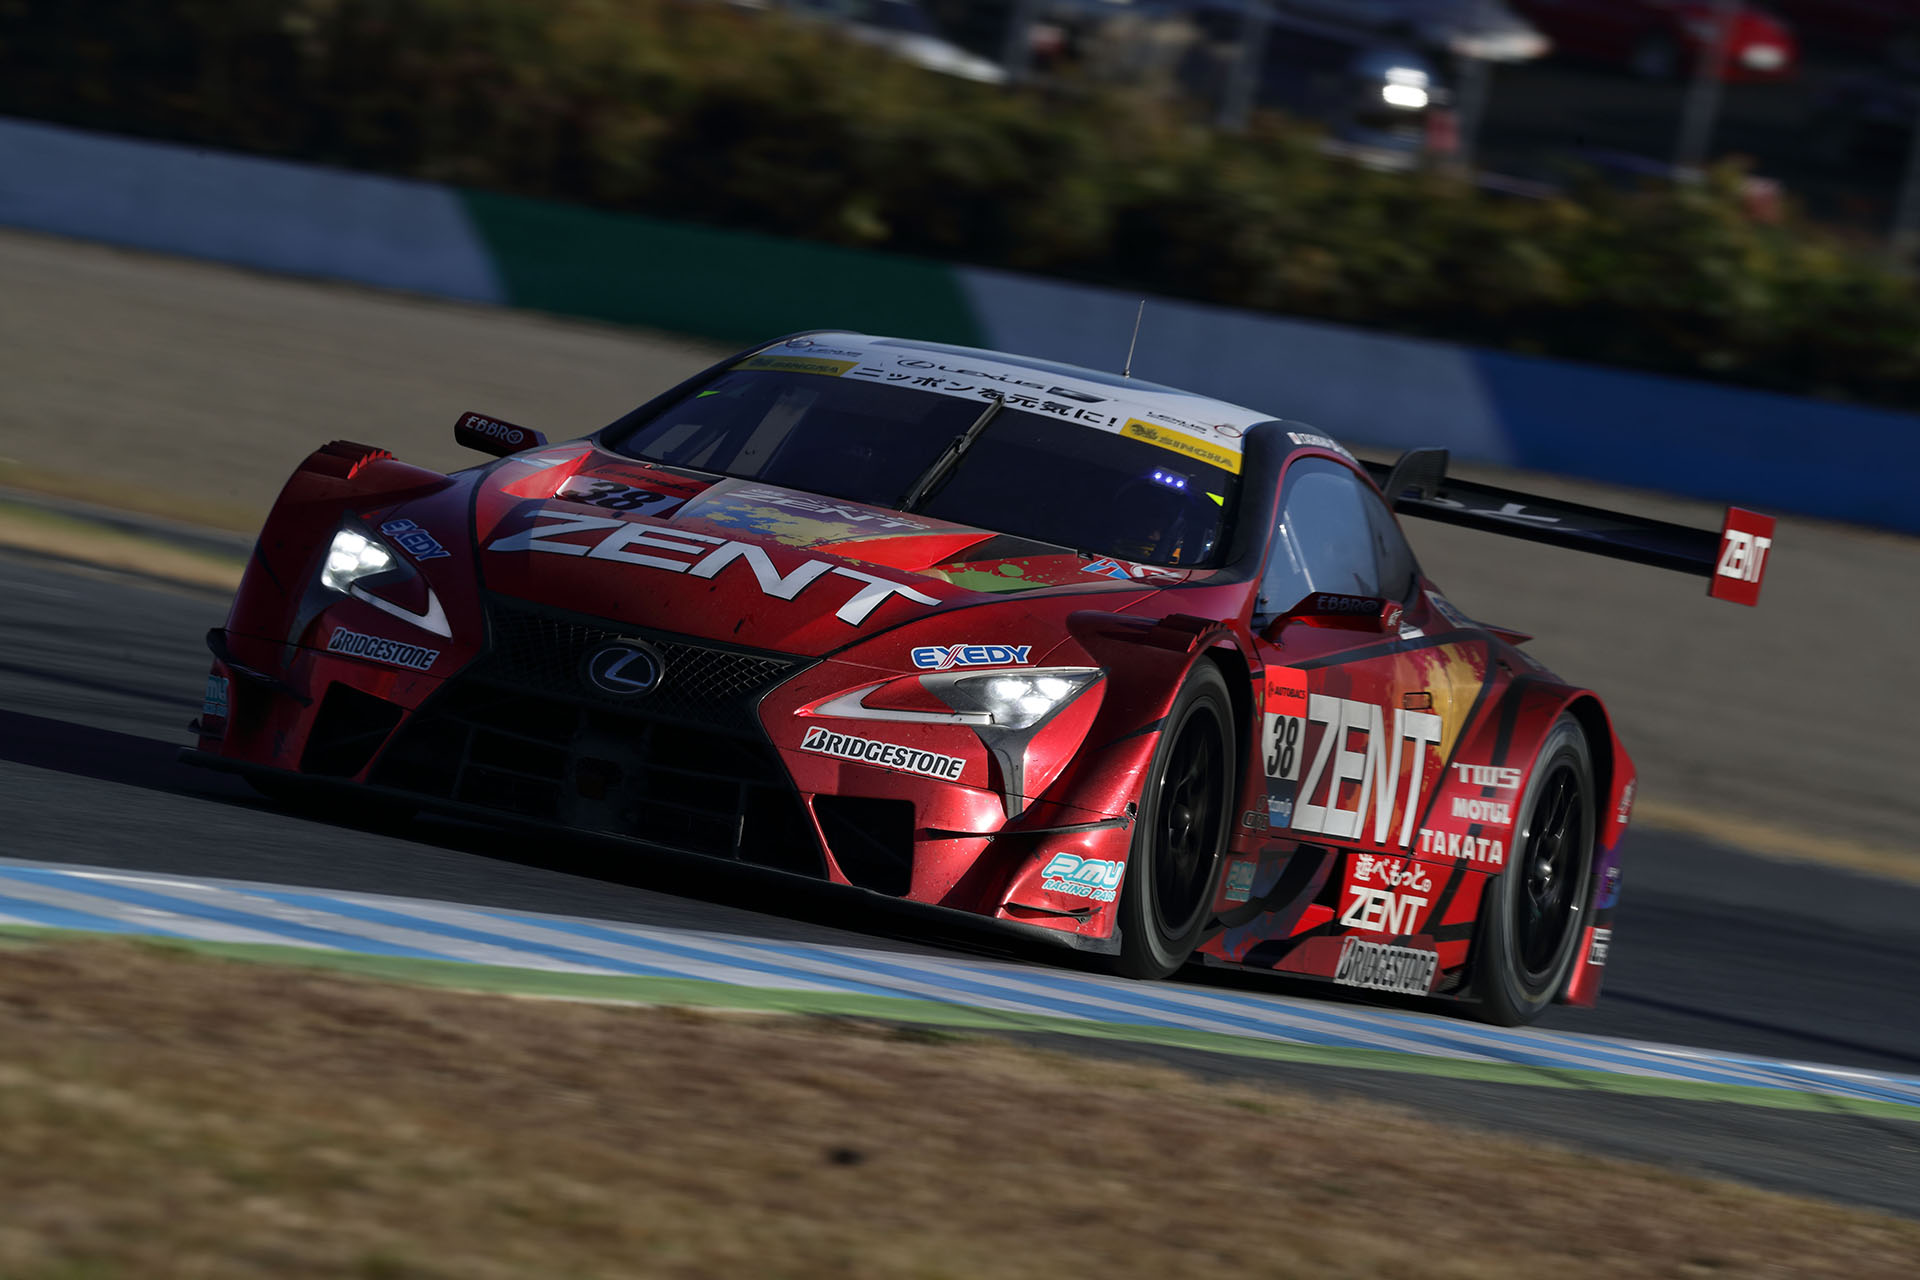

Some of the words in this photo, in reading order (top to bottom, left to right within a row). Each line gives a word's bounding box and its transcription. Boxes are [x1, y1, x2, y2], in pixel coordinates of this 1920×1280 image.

[938, 365, 1043, 390] LEXUS
[465, 416, 524, 445] EBBRO
[1159, 436, 1233, 468] SINGHA
[561, 481, 666, 510] 38
[724, 490, 926, 530] ZENT
[381, 519, 451, 562] EXEDY
[1716, 529, 1772, 584] ZENT
[488, 510, 942, 627] ZENT
[328, 626, 440, 670] BRIDGESTONE
[910, 644, 1033, 670] EXEDY
[801, 726, 966, 781] BRIDGESTONE
[1267, 715, 1299, 778] 38
[1290, 693, 1442, 848] ZENT
[1451, 797, 1512, 825] MOTUL
[1419, 828, 1503, 865] TAKATA
[1043, 879, 1093, 897] RACING
[1340, 885, 1429, 936] ZENT
